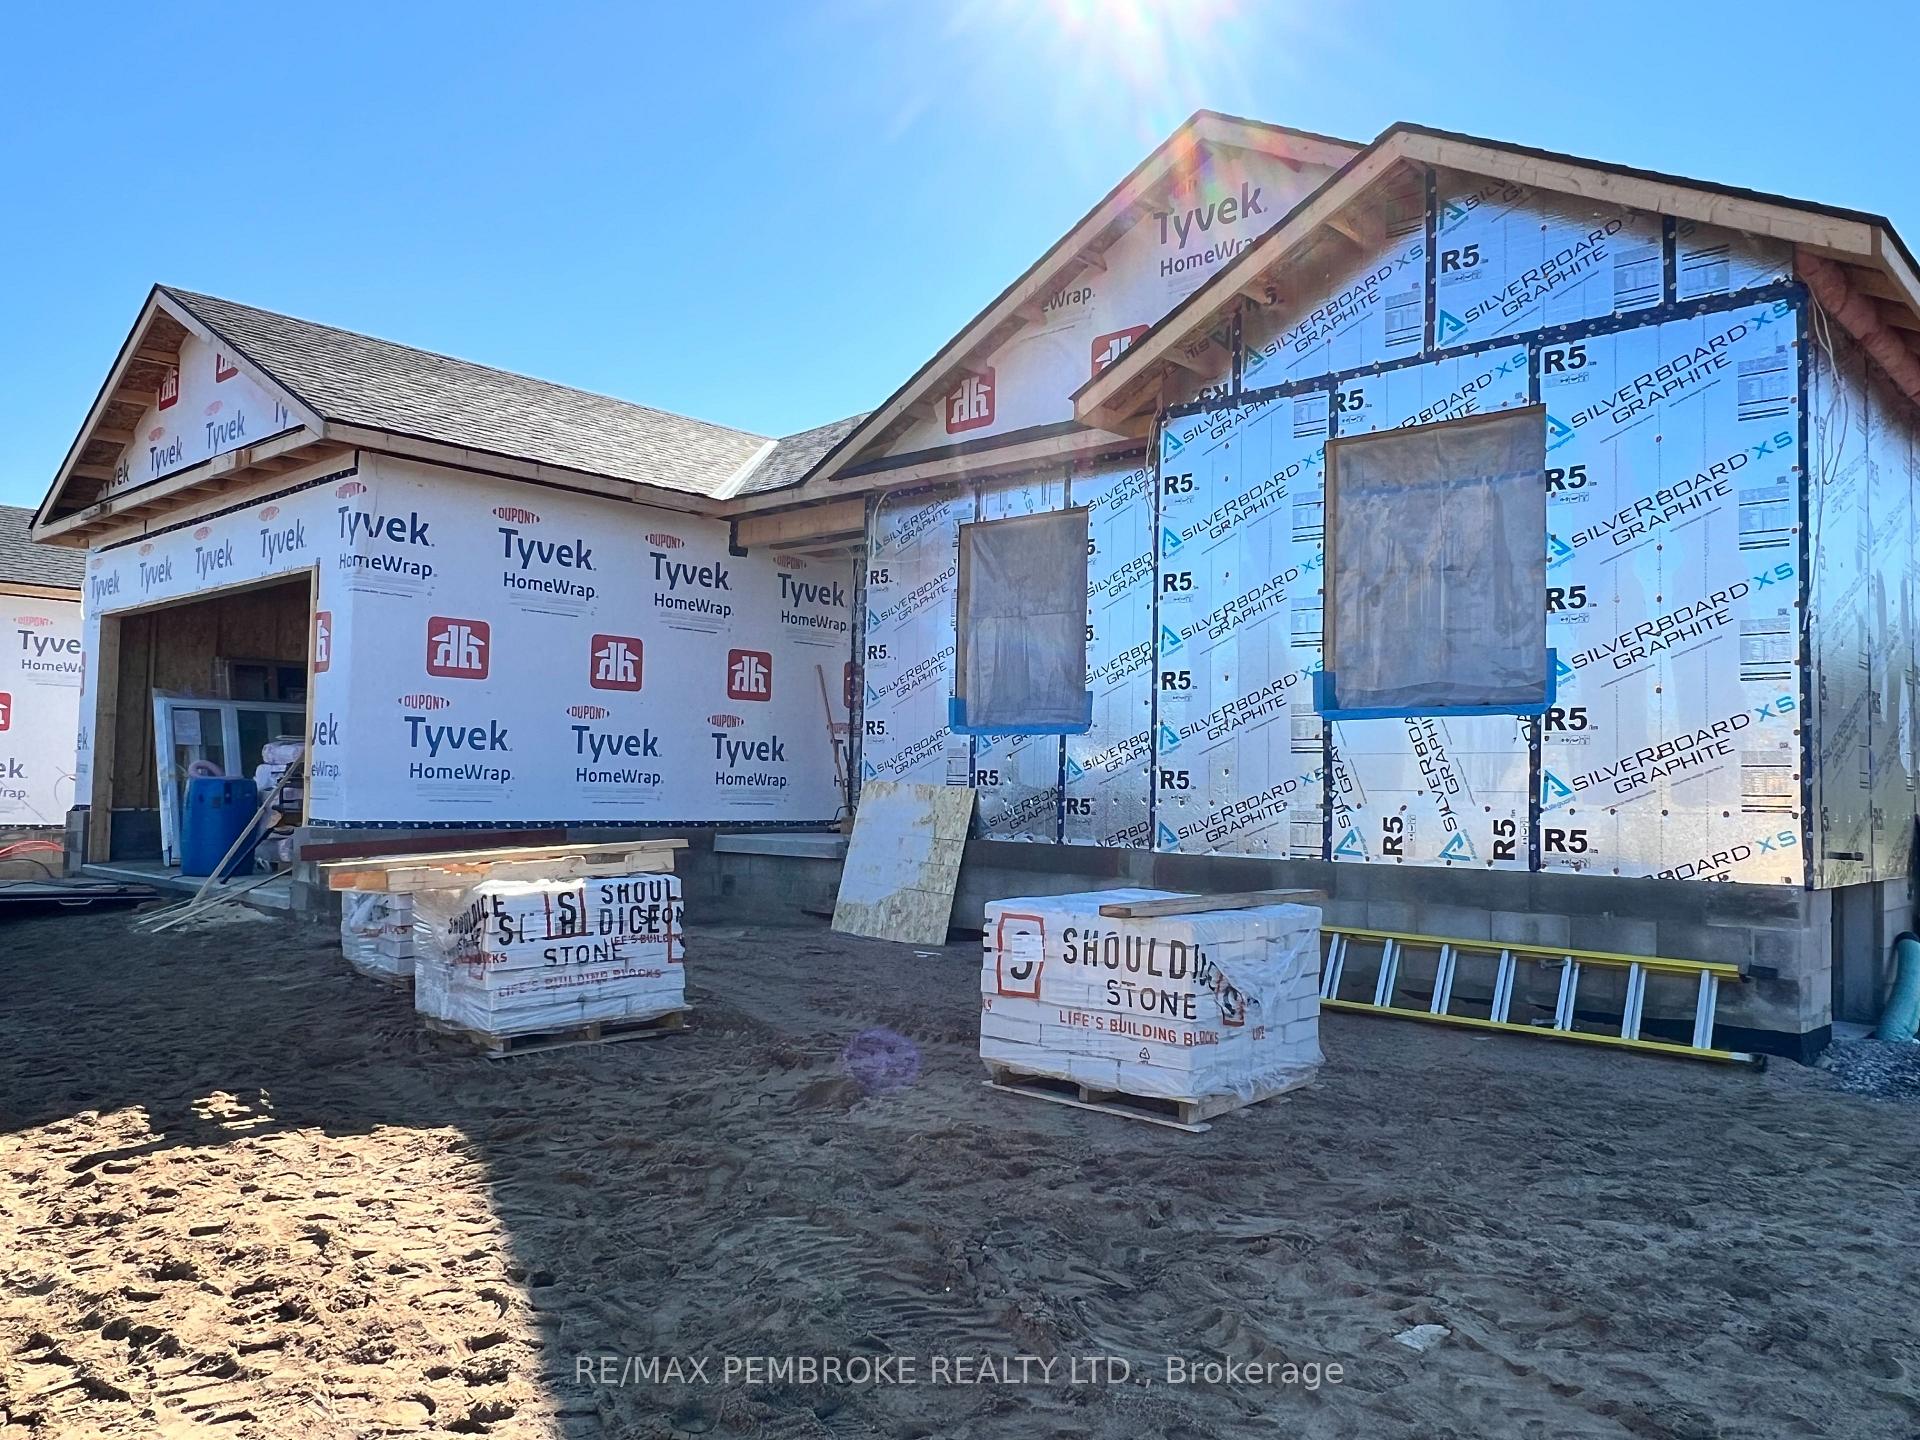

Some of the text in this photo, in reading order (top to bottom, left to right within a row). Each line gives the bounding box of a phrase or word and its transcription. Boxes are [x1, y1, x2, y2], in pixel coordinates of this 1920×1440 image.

[1153, 181, 1262, 249] Tyvek
[1441, 244, 1479, 274] R5
[1464, 220, 1622, 324] SILVERBOARD
[1502, 244, 1608, 318] GRAPHITE
[1264, 266, 1392, 357] SILVERBOARD
[1395, 245, 1424, 271] XS
[1294, 288, 1380, 353] GRAPHITE
[1495, 352, 1528, 378] XS
[1544, 346, 1587, 374] R5
[1572, 324, 1747, 428] SILVERBOARD
[1612, 352, 1732, 424] GRAPHITE
[206, 410, 245, 454] Tyvek
[150, 436, 182, 476] Tyvek
[1164, 473, 1193, 495] R5
[1544, 464, 1587, 492] R5
[1572, 454, 1748, 548] SILVERBOARD
[1752, 431, 1793, 459] XS
[498, 507, 536, 524] DUPONT
[1182, 464, 1299, 540] SILVERBOARD
[1209, 485, 1288, 540] GRAPHITE
[1612, 480, 1733, 546] GRAPHITE
[260, 519, 305, 564] Tyvek
[338, 506, 430, 547] Tyvek
[650, 533, 682, 548] DUPONT
[900, 504, 950, 544] GRAPHITE
[195, 539, 232, 580] Tyvek
[340, 553, 432, 580] HomeWrap
[499, 528, 593, 570] Tyvek
[91, 569, 120, 604] Tyvek
[140, 556, 172, 593] Tyvek
[503, 572, 595, 600] HomeWrap
[650, 552, 730, 590] Tyvek
[870, 569, 888, 585] R5
[1163, 572, 1192, 592] R5
[654, 592, 731, 619] HomeWrap
[778, 573, 844, 608] Tyvek
[880, 567, 956, 622] SILVERBOARD
[898, 583, 950, 622] GRAPHITE
[1180, 568, 1298, 640] SILVERBOARD
[1545, 585, 1587, 611] R5
[18, 616, 48, 626] DUPONT
[781, 610, 846, 632] HomeWrap
[1208, 588, 1288, 640] GRAPHITE
[1572, 582, 1749, 670] SILVERBOARD
[1753, 562, 1794, 590] XS
[18, 630, 81, 656] Tyve
[868, 645, 887, 660] R5
[1612, 608, 1734, 670] GRAPHITE
[878, 646, 954, 698] SILVERBOARD
[896, 662, 947, 698] GRAPHITE
[1161, 670, 1190, 690] R5
[404, 694, 446, 710] DUPONT
[571, 706, 606, 719] DUPONT
[1179, 674, 1297, 740] SILVERBOARD
[1208, 694, 1287, 740] GRAPHITE
[1544, 708, 1588, 731] R5
[404, 716, 508, 758] Tyvek
[711, 714, 742, 728] DUPONT
[866, 720, 885, 736] R5
[572, 726, 658, 764] Tyvek
[712, 733, 785, 767] Tyvek
[876, 726, 950, 773] SILVERBOARD
[894, 741, 944, 774] GRAPHITE
[1572, 714, 1750, 792] SILVERBOARD
[1754, 696, 1796, 722] XS
[410, 762, 511, 784] HomeWrap
[576, 768, 660, 788] HomeWrap
[716, 772, 786, 790] HomeWrap
[976, 770, 998, 786] R5
[1160, 770, 1190, 790] R5
[1614, 738, 1735, 794] GRAPHITE
[1066, 798, 1091, 816] R5
[1178, 780, 1296, 840] SILVERBOARD
[1206, 800, 1287, 842] GRAPHITE
[1382, 816, 1403, 856] R5
[1492, 819, 1516, 860] R5
[1544, 829, 1588, 854] R5
[1756, 830, 1797, 854] XS
[601, 878, 677, 904] SHOUL
[600, 905, 660, 936] DICE
[544, 938, 622, 966] STONE
[1107, 980, 1197, 1020] STONE
[1059, 1010, 1219, 1046] LIFE'S BUILDING BLOCKS
